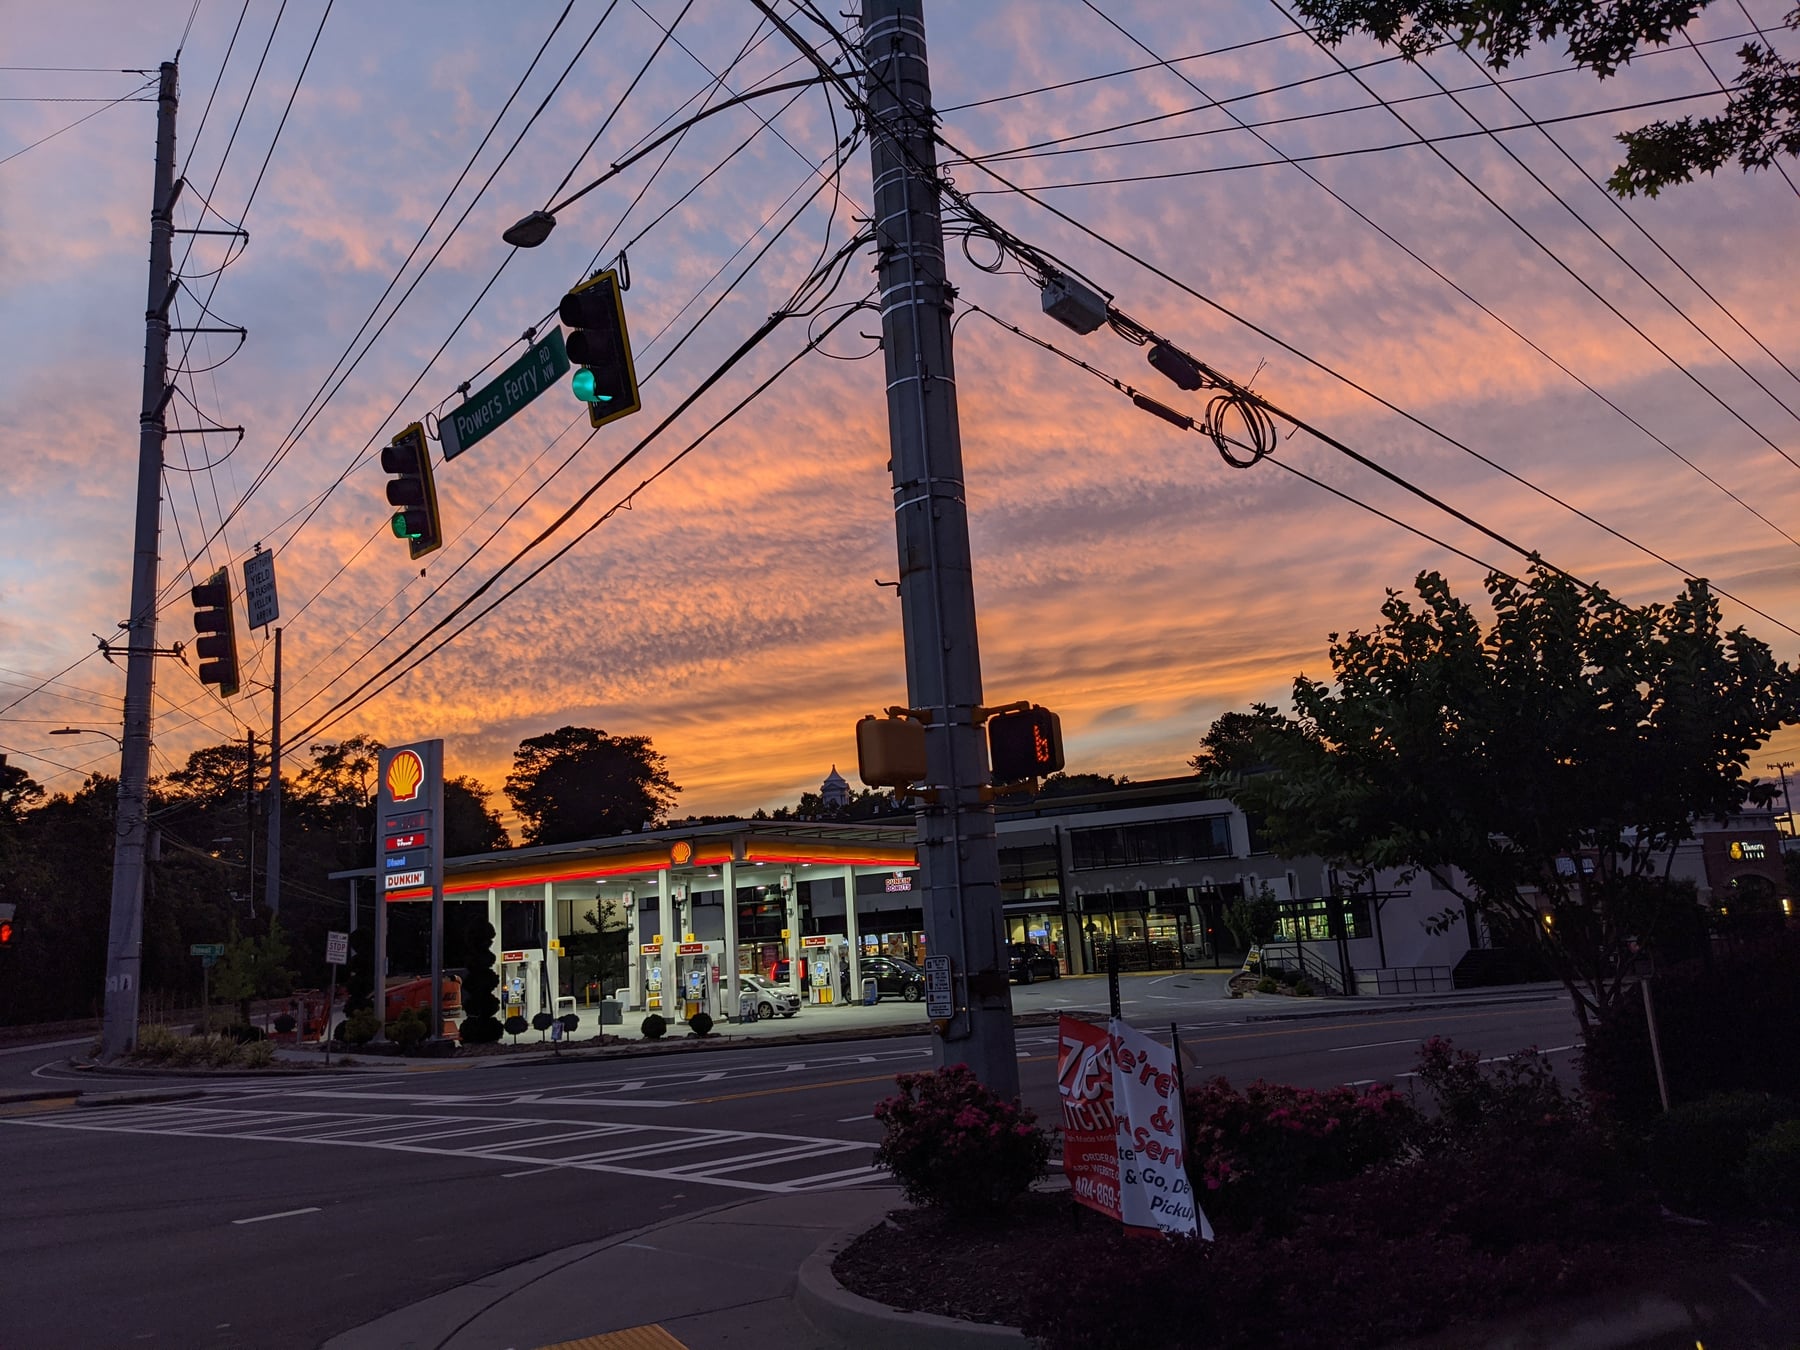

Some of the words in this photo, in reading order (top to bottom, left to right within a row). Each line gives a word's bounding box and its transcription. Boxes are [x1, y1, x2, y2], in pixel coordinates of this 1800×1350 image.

[538, 346, 551, 365] RD
[542, 364, 556, 383] NW
[457, 395, 503, 441] Powers
[503, 364, 538, 406] Ferry
[250, 568, 270, 587] YIELD
[387, 872, 422, 887] DUNKIN'
[885, 883, 912, 893] DONUTS
[329, 942, 346, 951] STOP
[1082, 1153, 1109, 1163] ORDER
[1125, 1169, 1138, 1185] &
